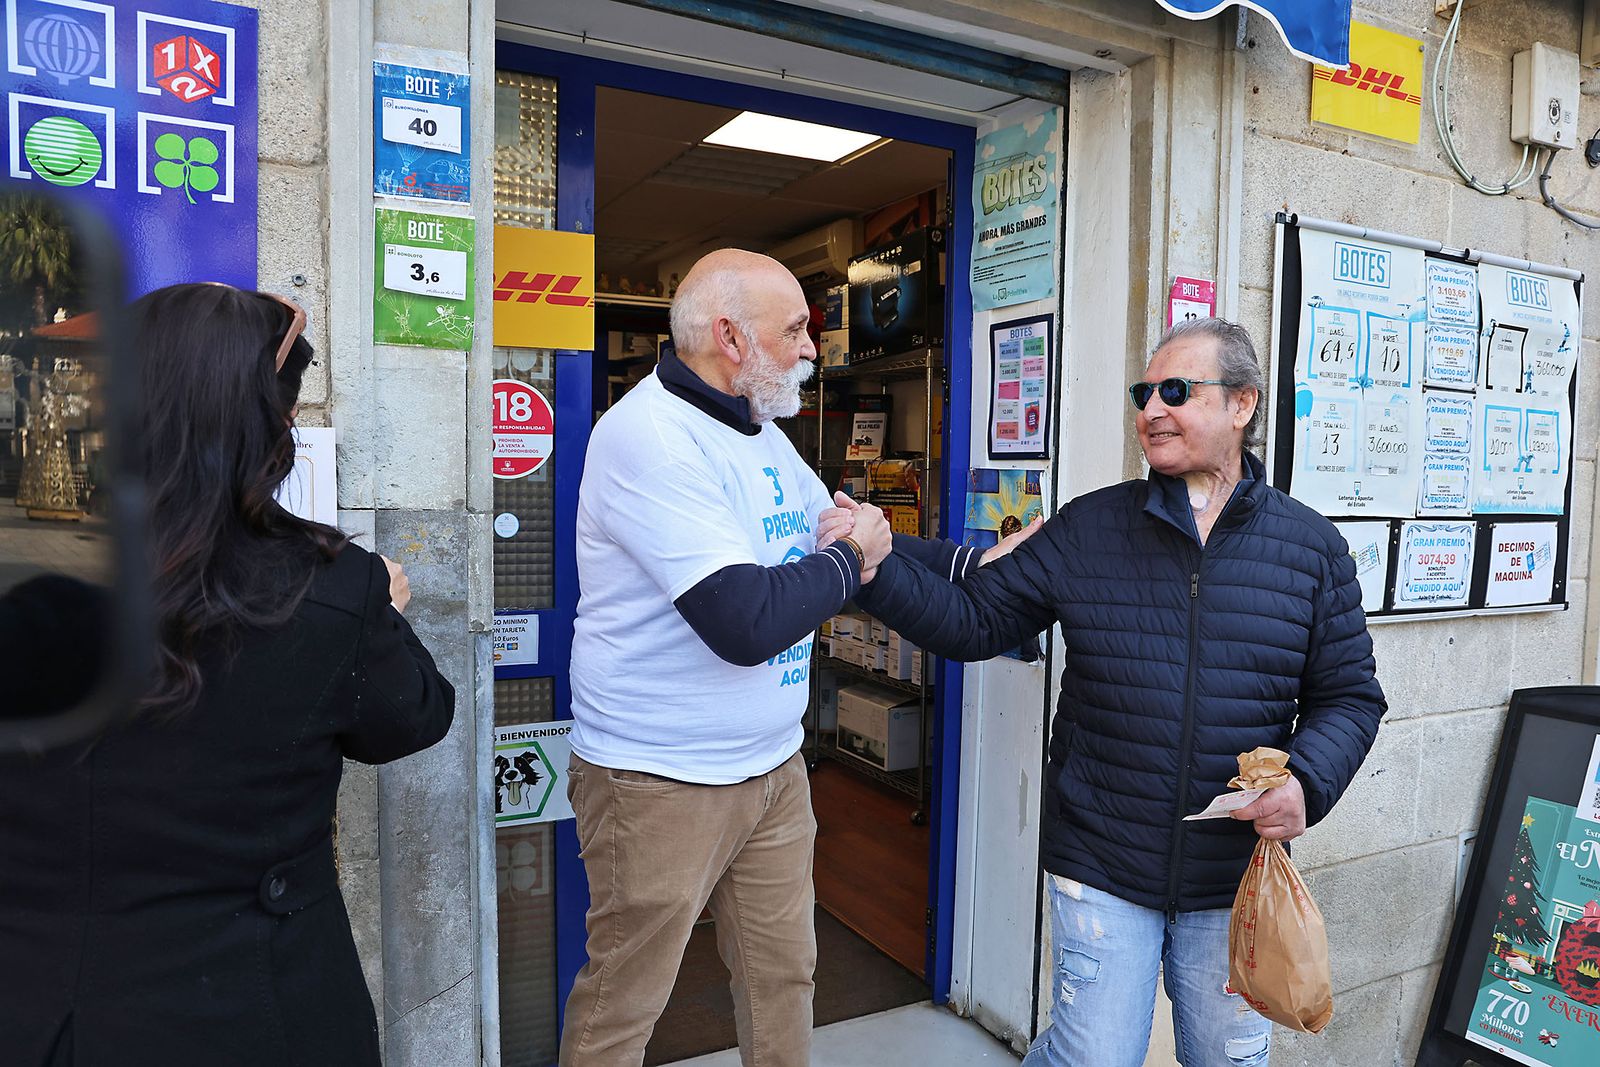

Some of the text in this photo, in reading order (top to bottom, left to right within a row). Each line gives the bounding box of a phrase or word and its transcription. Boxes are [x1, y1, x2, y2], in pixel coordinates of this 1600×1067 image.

[405, 74, 440, 96] BOTE
[1330, 62, 1408, 101] DHL
[408, 117, 438, 137] 40
[981, 155, 1049, 215] BOTES
[408, 220, 444, 241] BOTE
[1000, 222, 1015, 237] MÁS
[1016, 214, 1047, 233] GRANDES
[410, 263, 440, 284] 3,6
[1340, 247, 1385, 283] BOTES
[493, 271, 590, 306] HL
[1433, 274, 1470, 286] GRAN PREMIO
[1182, 282, 1200, 298] BOTE
[1511, 275, 1548, 307] BOTES
[1434, 307, 1458, 316] VENDIDO
[1010, 326, 1033, 339] BOTES
[1433, 335, 1471, 345] GRAN PREMIO
[1381, 345, 1400, 373] 10
[1433, 367, 1456, 376] VENDIDO
[493, 391, 533, 422] 18
[1430, 406, 1468, 416] GRAN PREMIO
[1321, 433, 1340, 456] 13
[1429, 439, 1453, 447] VENDIDO
[1428, 463, 1465, 472] GRAN PREMIO
[1427, 496, 1450, 504] VENDIDO
[762, 510, 811, 543] PREMIO
[1413, 538, 1465, 547] GRAN PREMIO
[1498, 541, 1535, 553] DECIMOS
[1418, 553, 1456, 566] 3074,39
[1510, 557, 1521, 567] DE
[1494, 570, 1533, 582] MAQUINA
[1408, 584, 1440, 593] VENDIDO
[502, 626, 526, 634] TARJETA
[780, 664, 808, 688] AQU
[500, 727, 572, 742] BIENVENIDOS
[1556, 842, 1577, 861] El
[1488, 989, 1530, 1026] 770
[1479, 1022, 1489, 1030] en
[1489, 1025, 1523, 1045] premios
[1480, 1012, 1524, 1039] Millones
